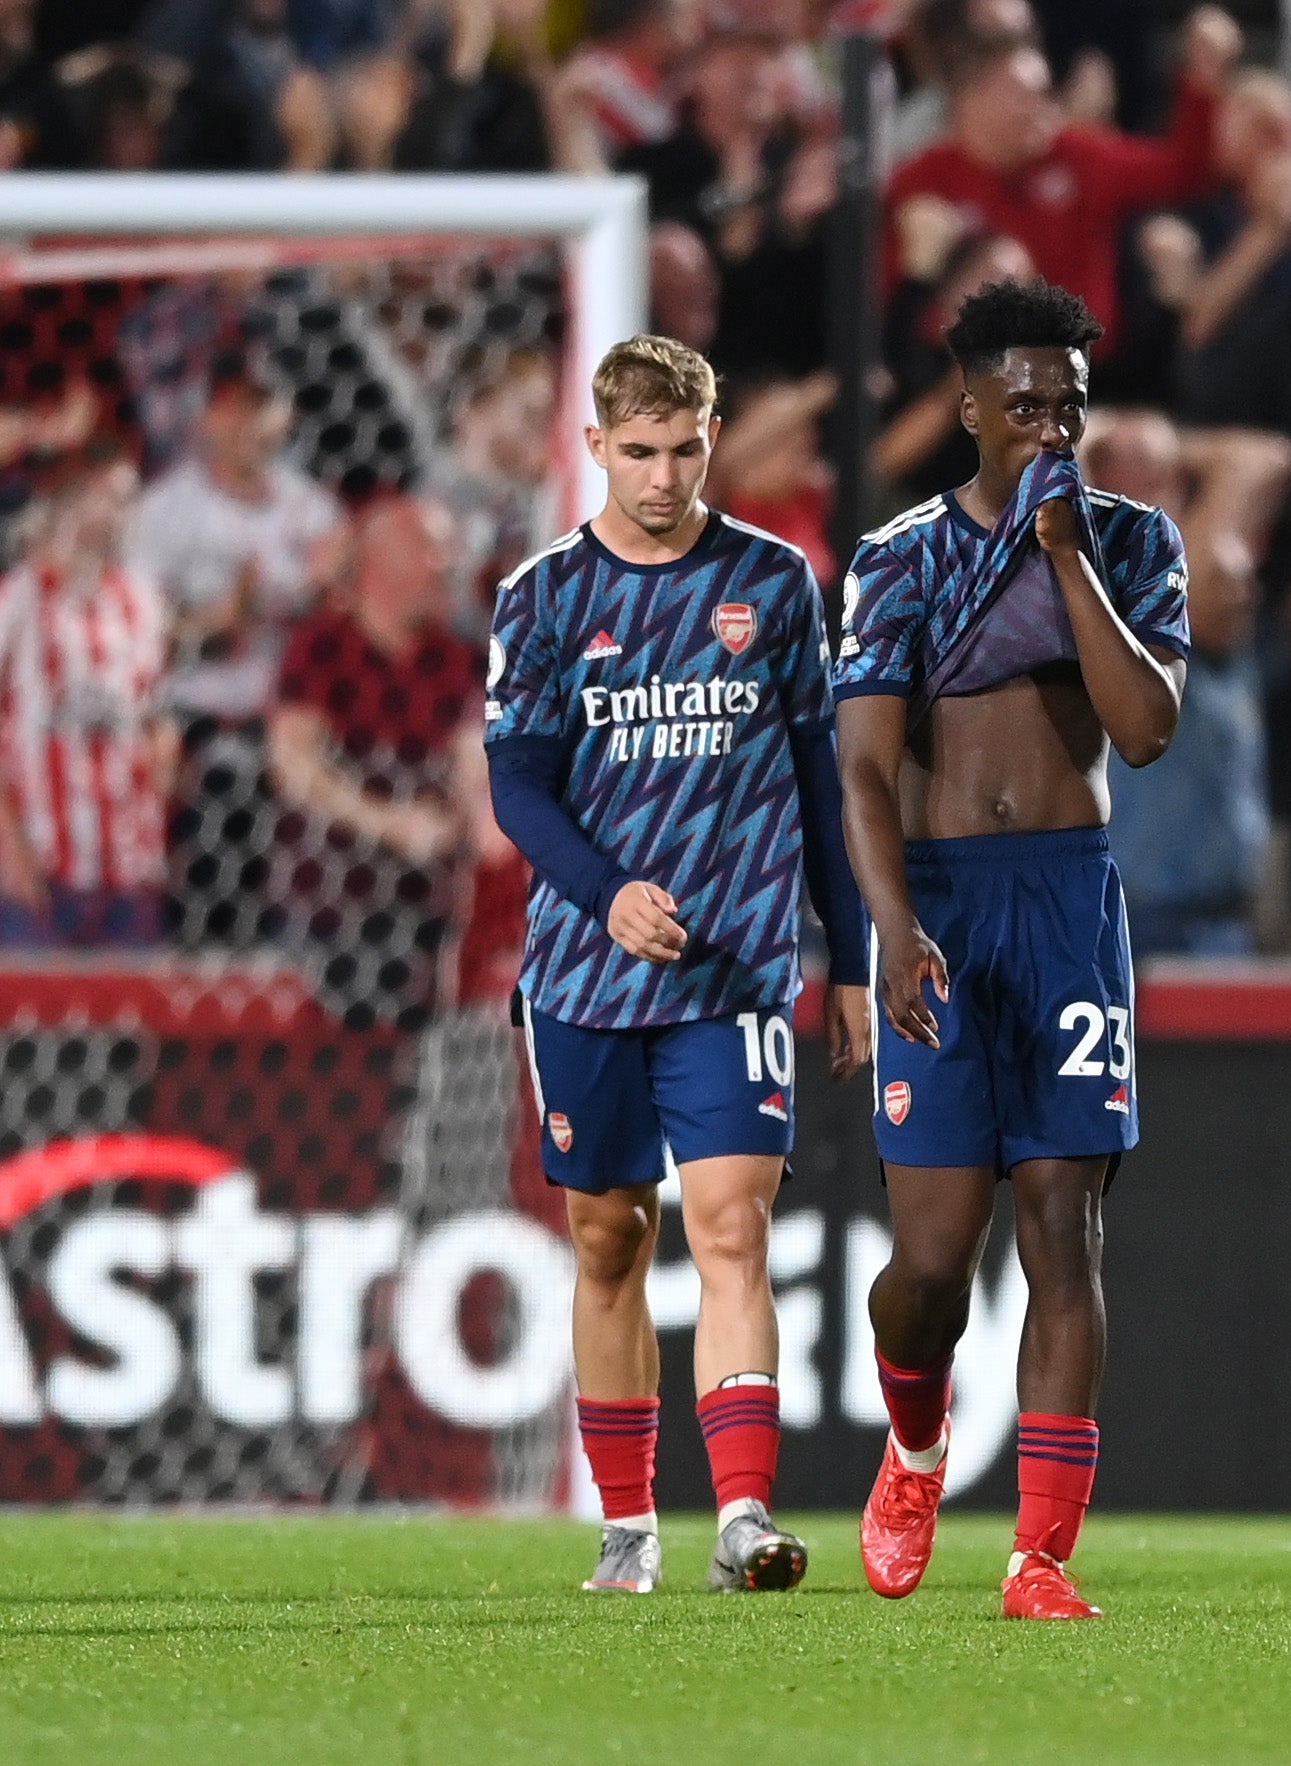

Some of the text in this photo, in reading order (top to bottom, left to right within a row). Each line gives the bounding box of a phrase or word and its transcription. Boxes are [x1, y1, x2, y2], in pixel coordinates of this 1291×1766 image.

[583, 644, 623, 660] adidas
[580, 674, 760, 727] Emirates
[608, 721, 734, 763] FLY BETTER
[736, 1011, 791, 1087] 10
[1057, 1001, 1129, 1080] 23
